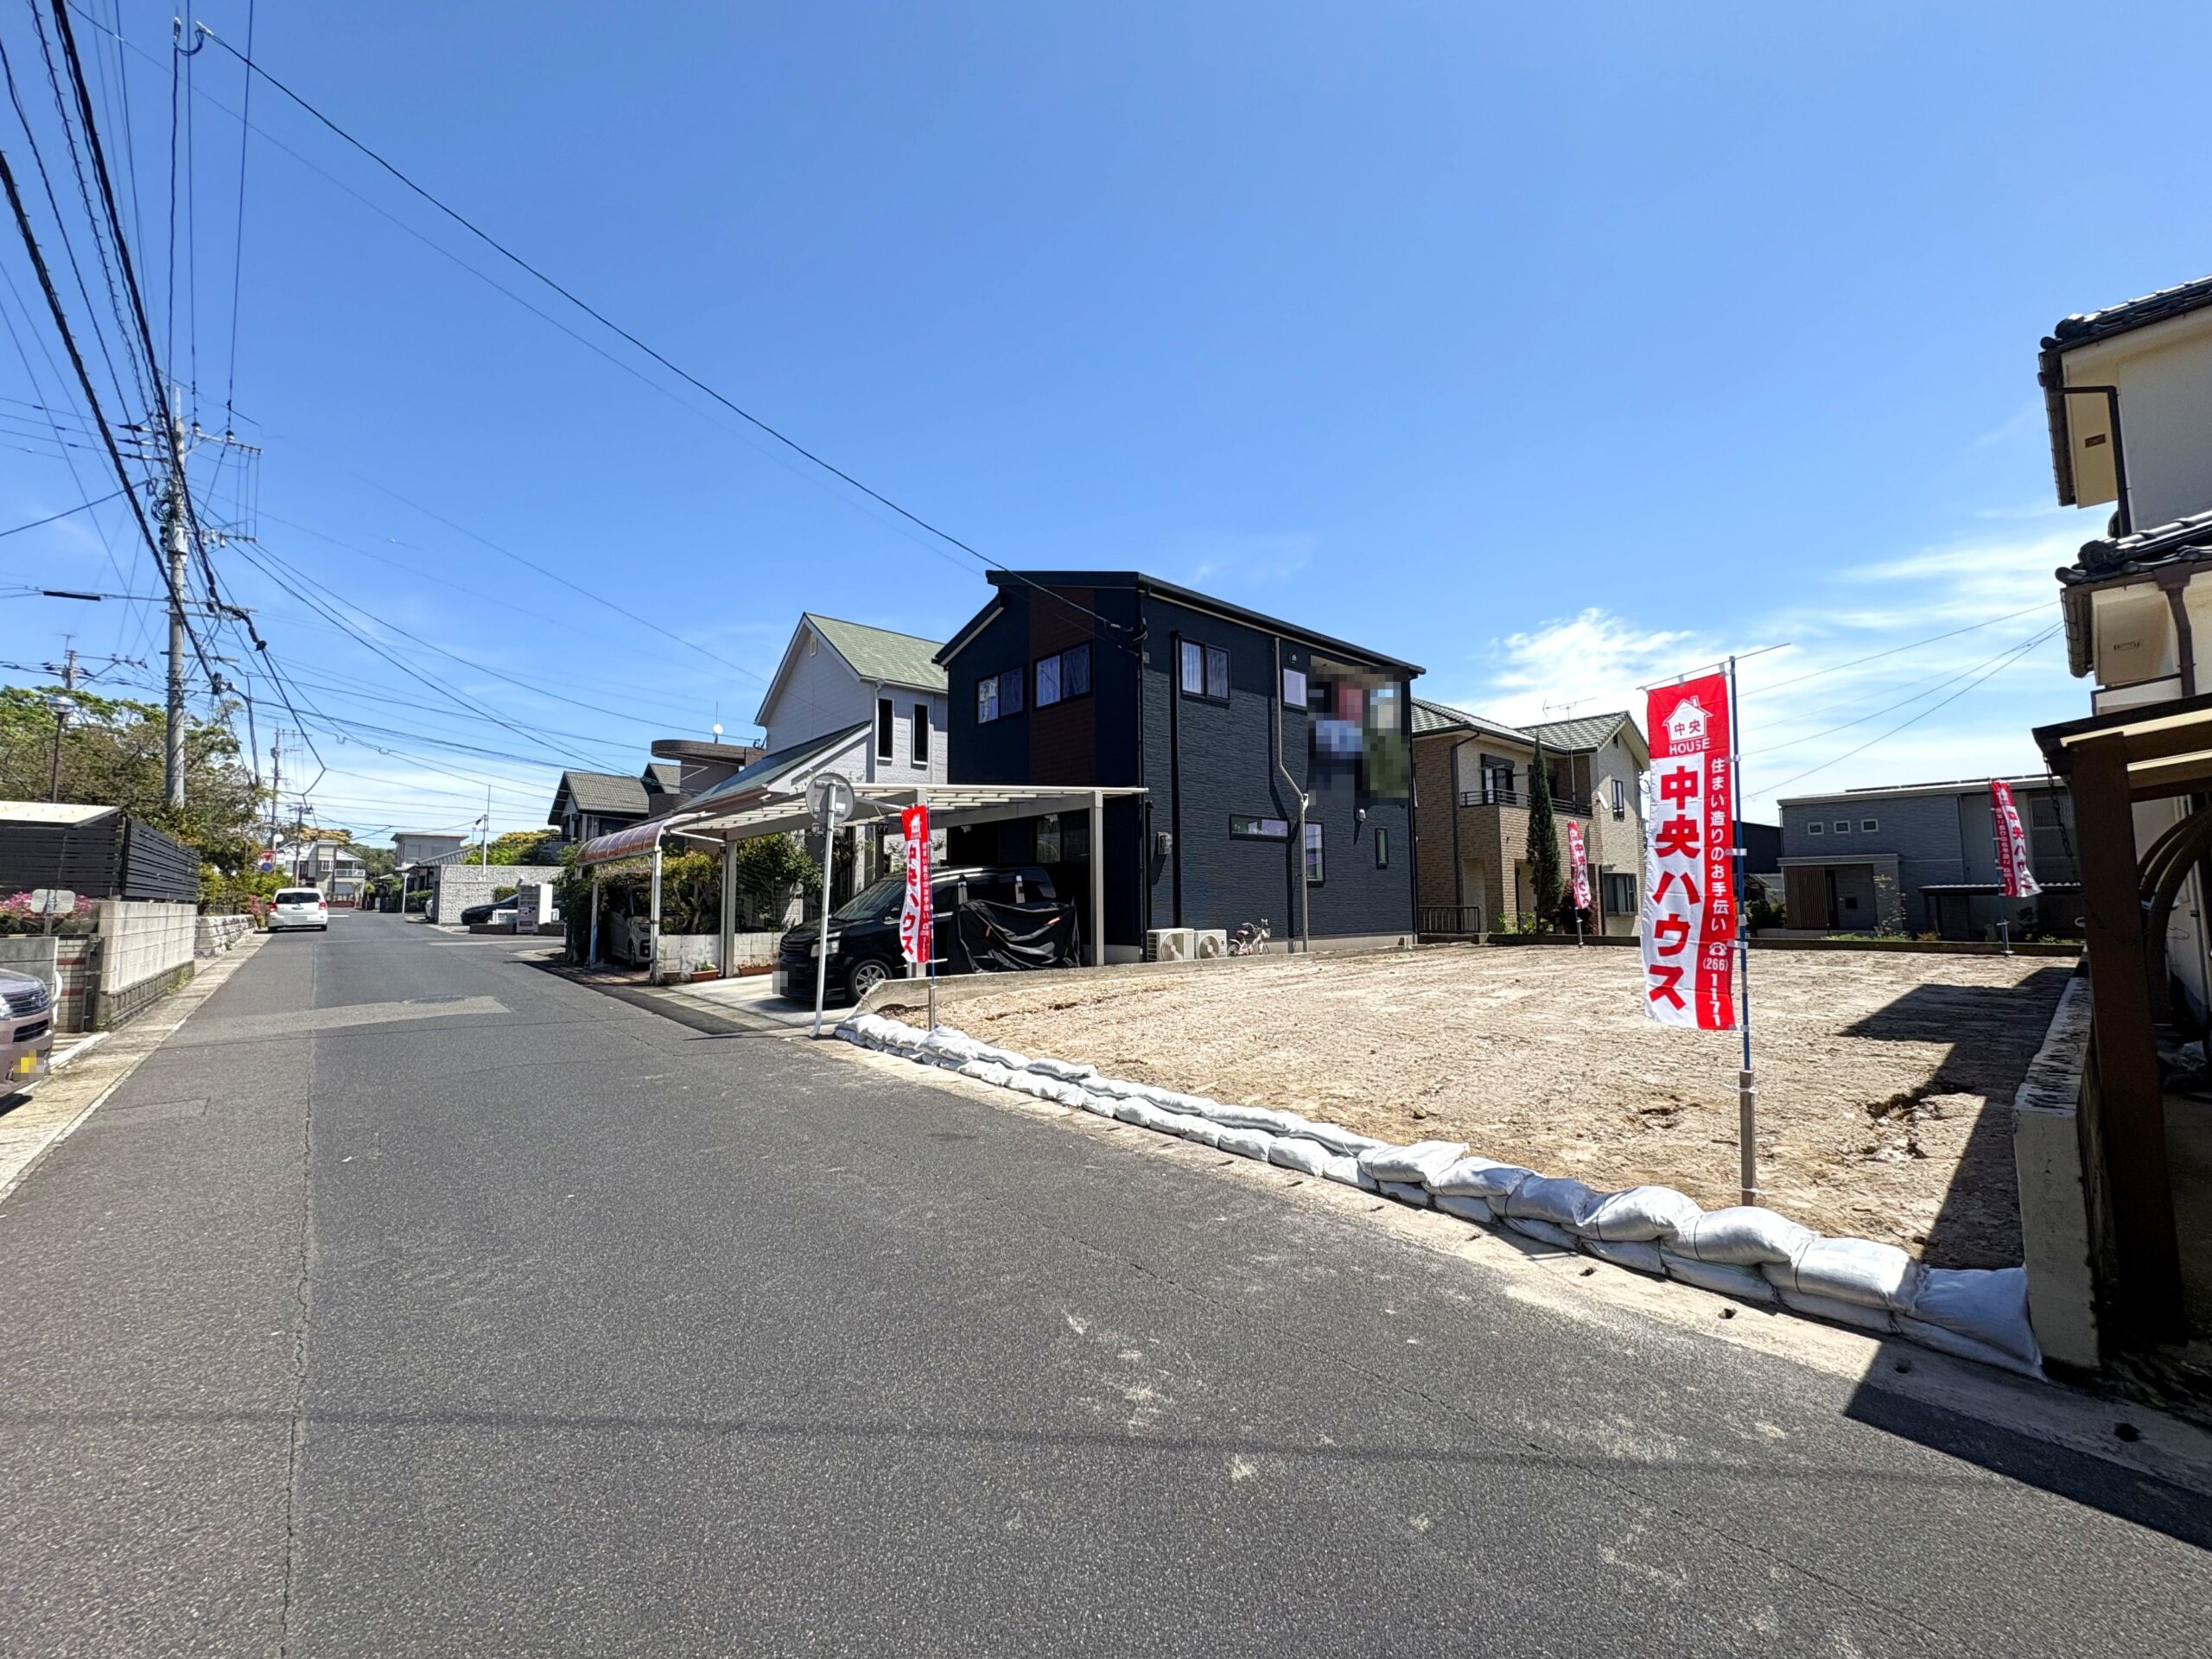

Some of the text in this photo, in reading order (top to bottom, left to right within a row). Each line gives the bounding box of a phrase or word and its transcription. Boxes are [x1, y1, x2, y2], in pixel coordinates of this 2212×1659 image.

[1675, 719, 1701, 736] 中央
[1669, 738, 1711, 755] HOUSE
[1710, 757, 1729, 932] 住まい造りのお手伝い
[1648, 766, 1701, 1011] 中央ハウス
[1702, 957, 1729, 972] (266)
[1709, 973, 1721, 1027] 1171
